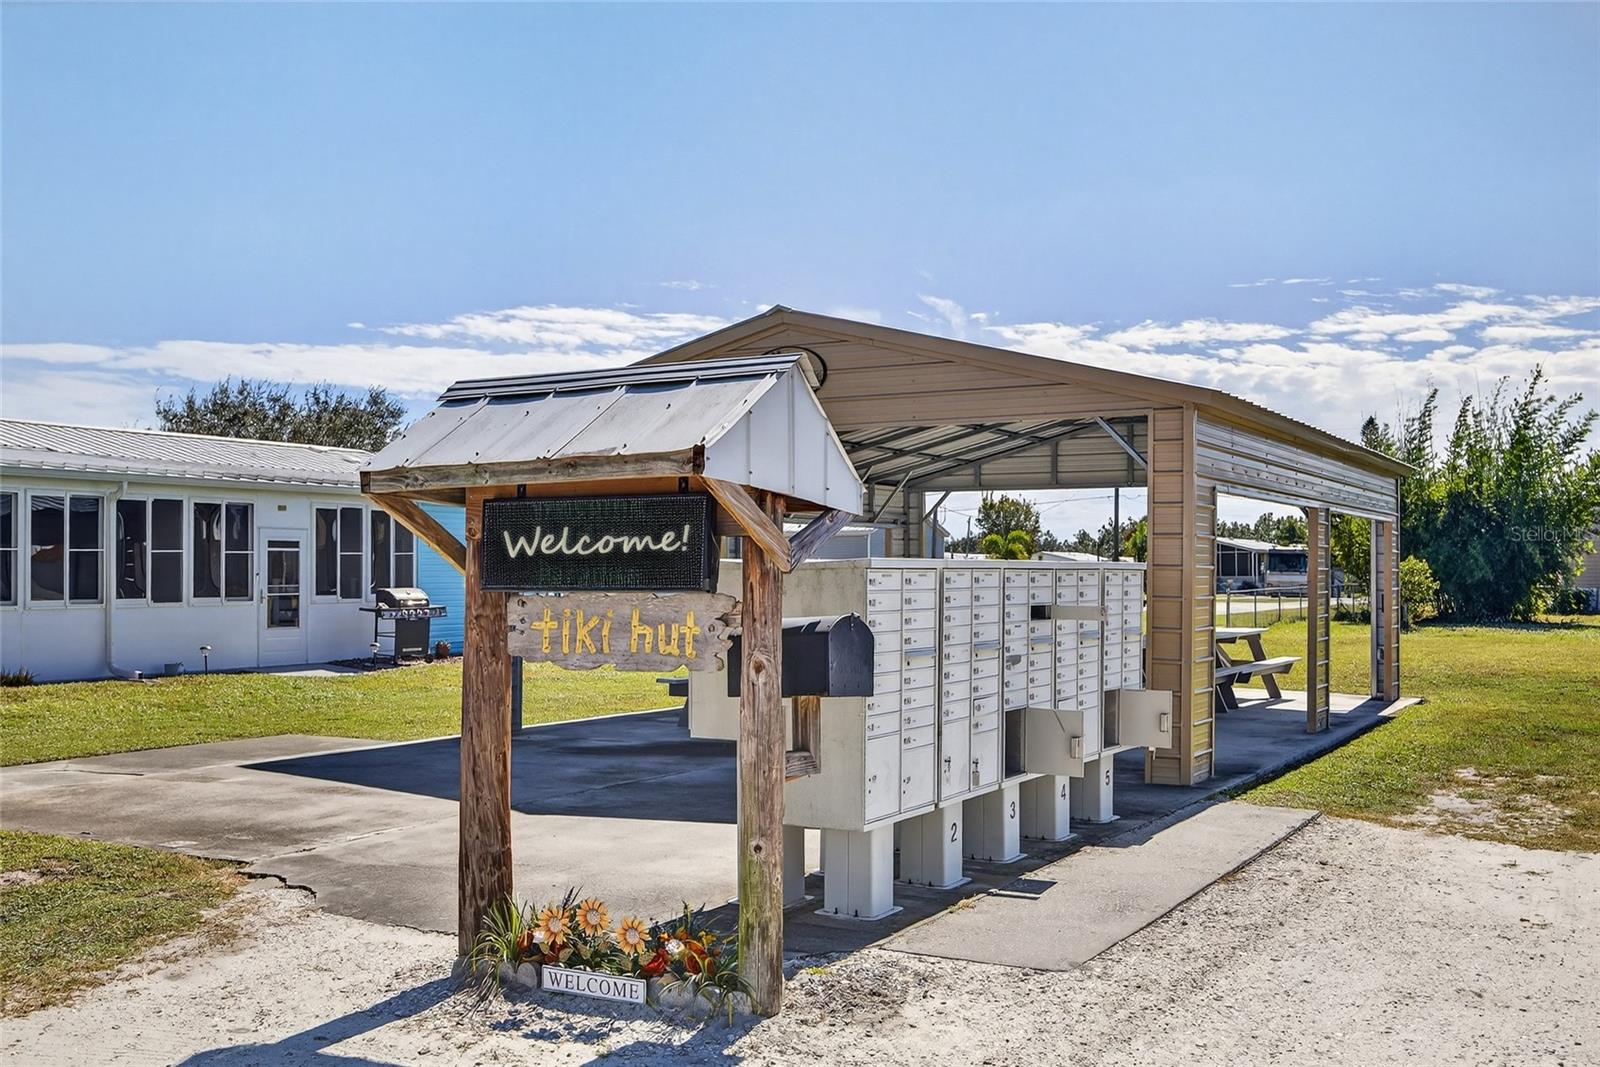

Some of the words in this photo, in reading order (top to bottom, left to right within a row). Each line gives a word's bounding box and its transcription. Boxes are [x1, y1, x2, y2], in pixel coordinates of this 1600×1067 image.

[503, 524, 690, 558] Welcome!
[531, 608, 613, 654] tiki
[630, 608, 702, 658] hut
[1105, 769, 1111, 786] 5
[1060, 783, 1067, 801] 4
[1009, 800, 1016, 819] 3
[950, 822, 958, 843] 2
[548, 970, 640, 1000] WELCOME
